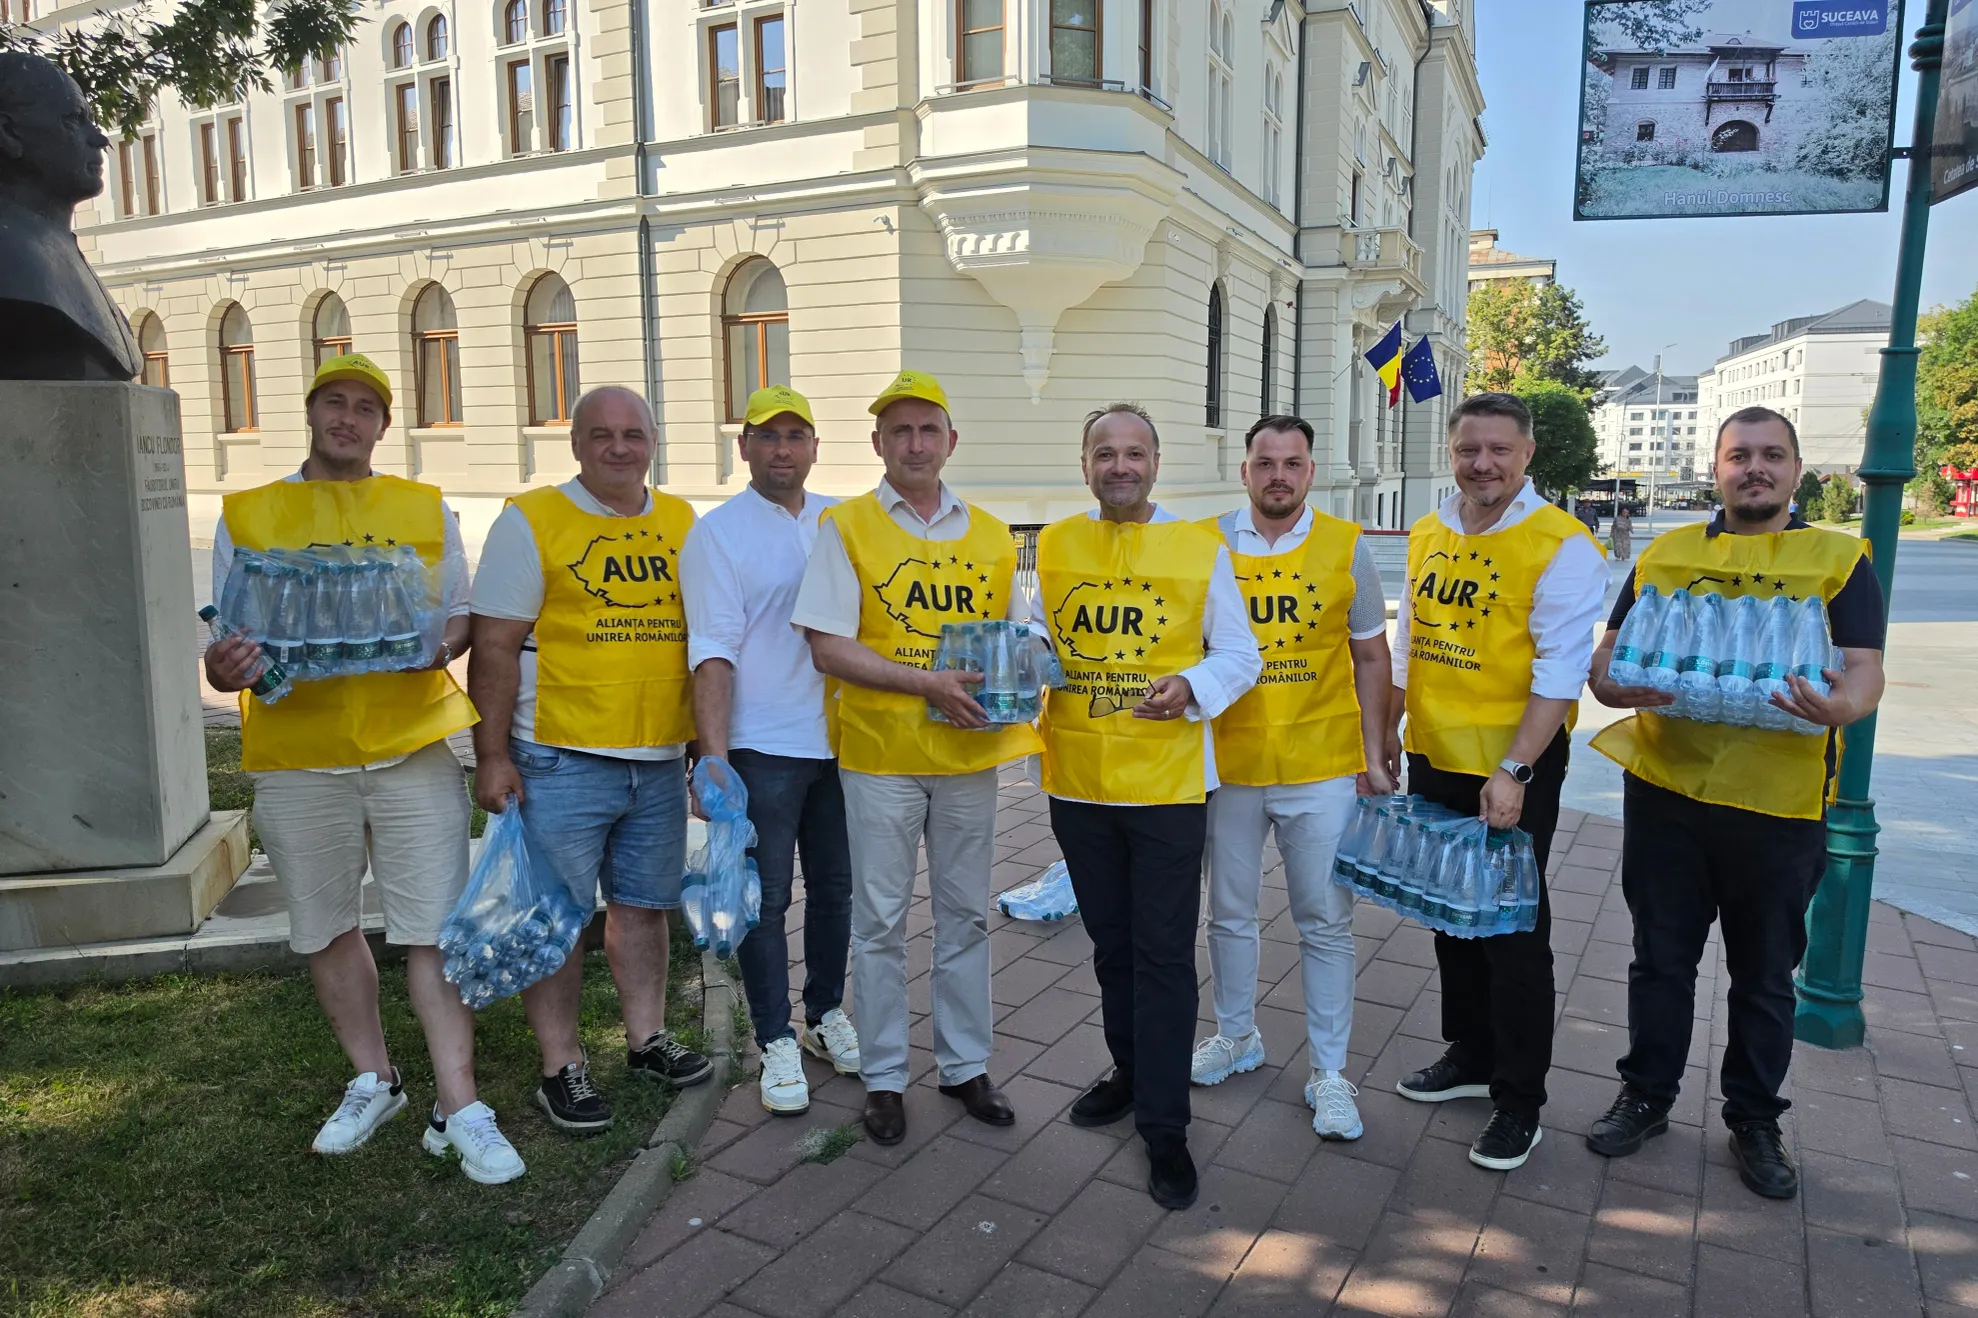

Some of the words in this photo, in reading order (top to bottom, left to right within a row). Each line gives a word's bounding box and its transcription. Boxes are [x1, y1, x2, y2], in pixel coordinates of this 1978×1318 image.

[1821, 10, 1878, 23] SUCEAVA
[1943, 162, 1965, 184] Cetatea
[1965, 155, 1975, 172] de
[1664, 190, 1712, 206] Hanul
[1717, 190, 1792, 204] Domnesc
[353, 360, 370, 369] AUR
[136, 435, 155, 454] IANCU
[156, 436, 181, 455] FLONDOR
[603, 555, 673, 583] AUR
[905, 580, 976, 614] AUR
[1417, 571, 1479, 609] AUR
[1250, 595, 1300, 624] UR
[647, 619, 681, 629] PENTRU
[1071, 604, 1143, 636] AUR
[586, 632, 633, 643] UNIREA
[1433, 639, 1476, 657] PENTRU
[1266, 659, 1308, 670] PENTRU
[1419, 650, 1481, 671] ROMÂNILOR
[1065, 670, 1103, 684] ALIANȚA
[1106, 672, 1147, 683] PENTRU
